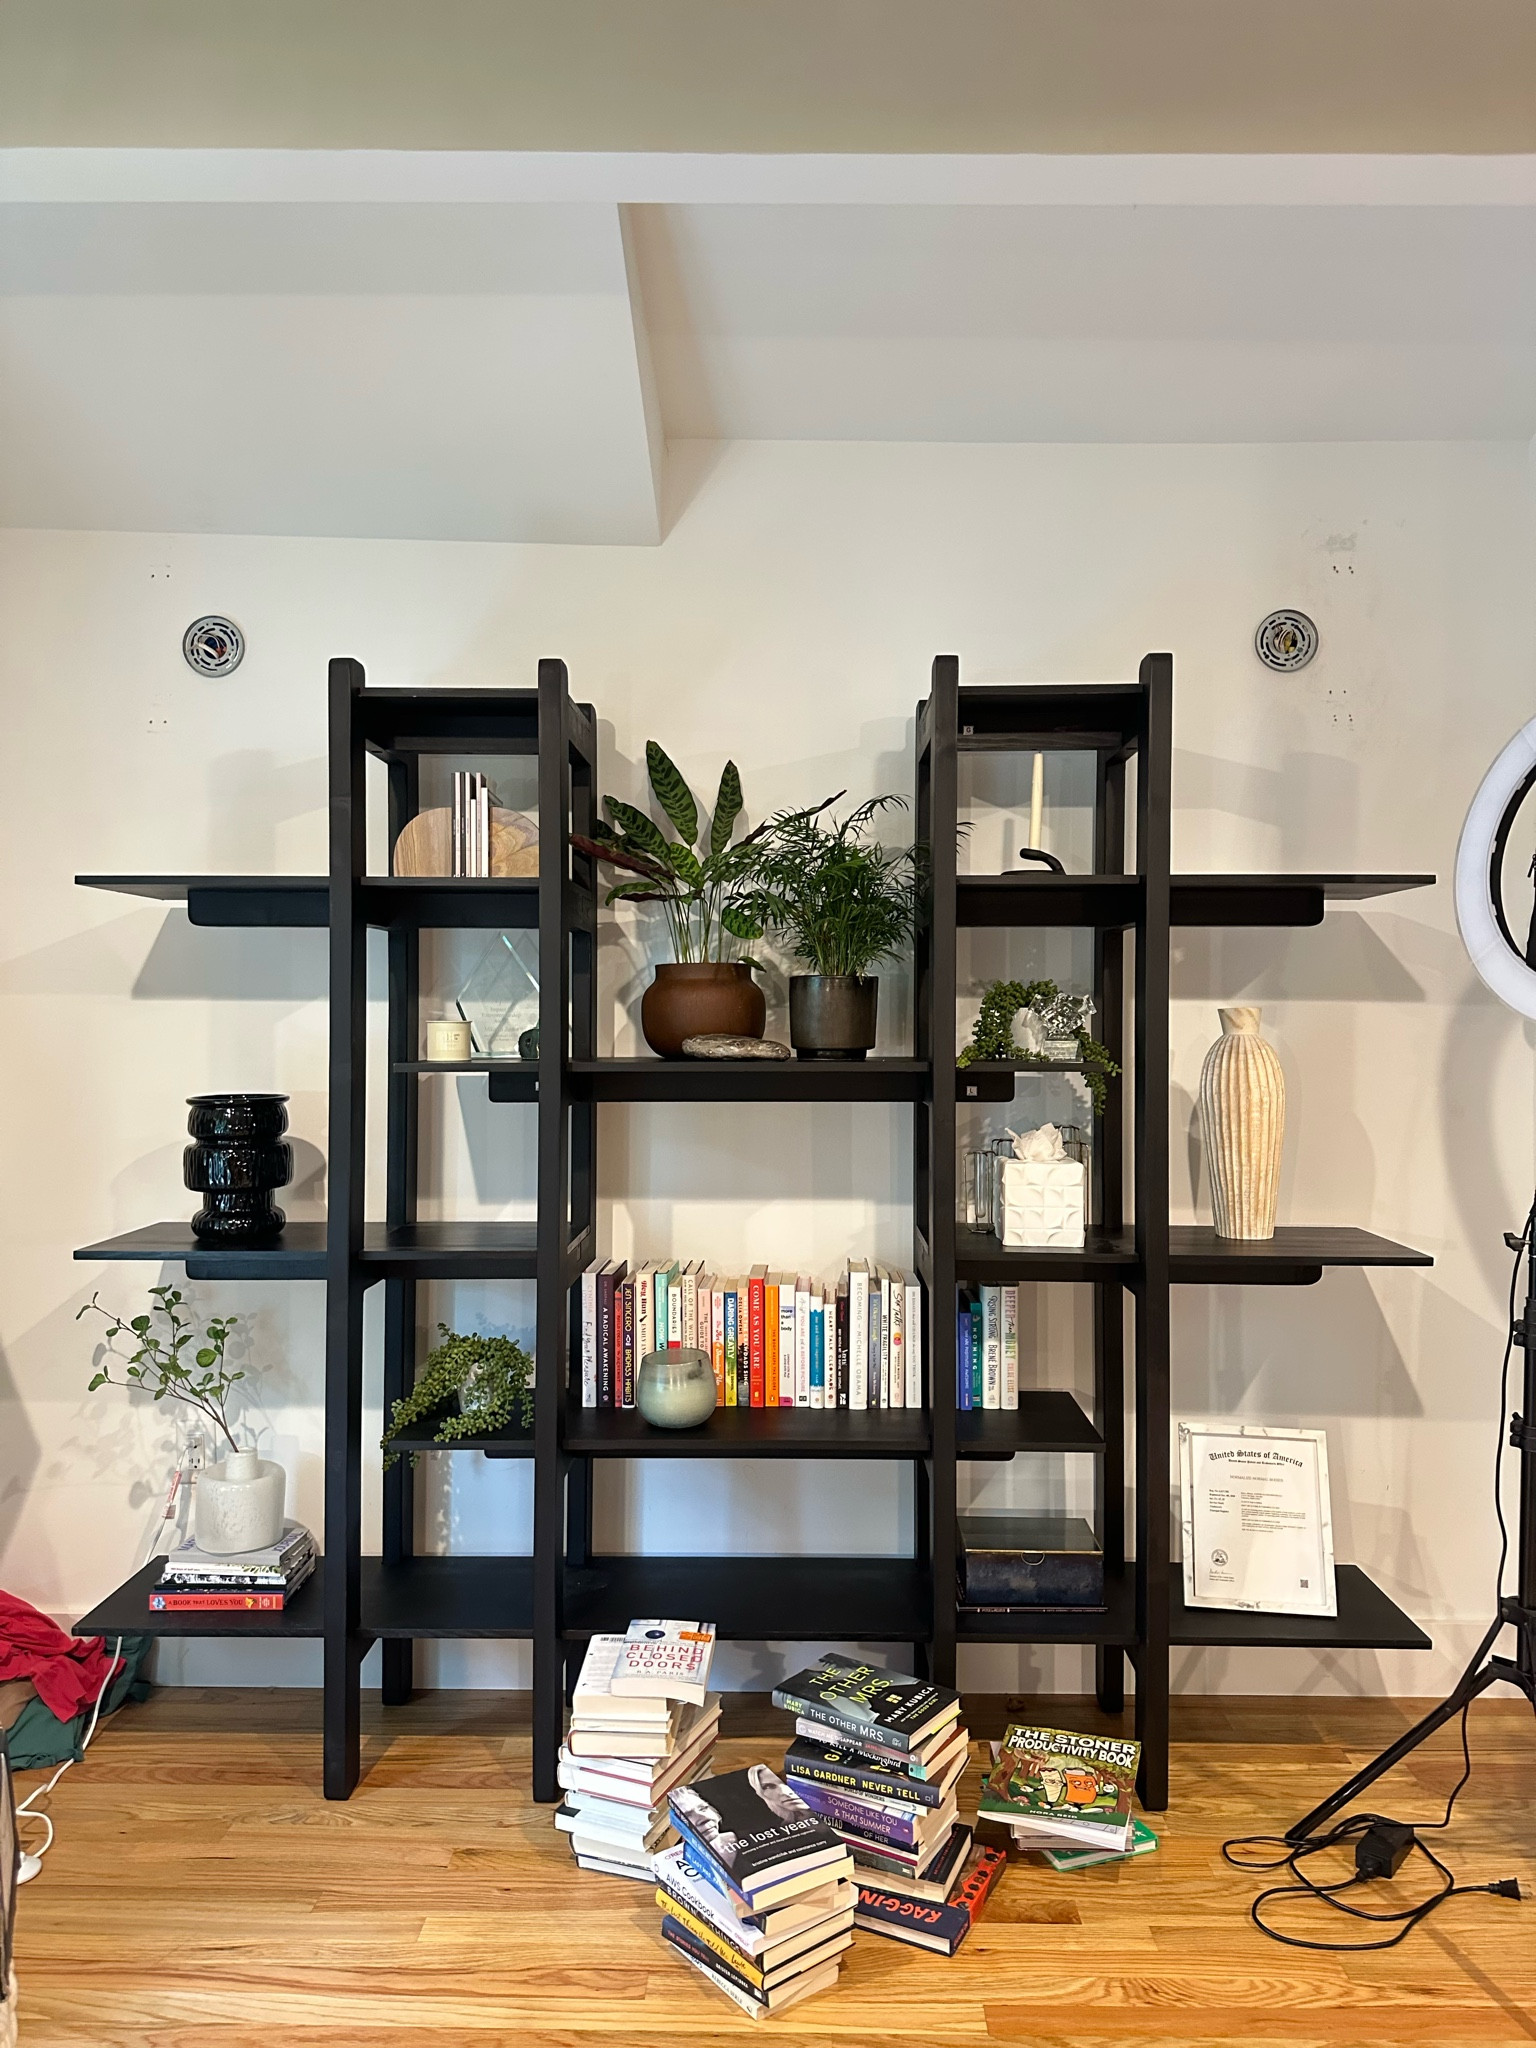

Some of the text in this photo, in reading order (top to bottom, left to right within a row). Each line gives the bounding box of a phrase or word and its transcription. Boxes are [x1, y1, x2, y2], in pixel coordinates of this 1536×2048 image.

[688, 1298, 694, 1306] OF
[893, 1290, 903, 1327] Sex Talks
[753, 1314, 760, 1326] AS
[988, 1318, 998, 1339] STRONG
[1005, 1290, 1016, 1360] DEEPER MONEY
[700, 1340, 704, 1348] TO
[714, 1348, 722, 1374] Showing
[988, 1364, 998, 1385] BROWN
[1208, 1450, 1234, 1460] United
[1236, 1450, 1262, 1458] States
[1272, 1452, 1303, 1468] America
[626, 1652, 703, 1663] CLOSED
[630, 1644, 704, 1655] BEHIND
[629, 1660, 696, 1671] DOORS
[809, 1666, 842, 1685] THE
[820, 1666, 874, 1700] OTHER
[850, 1678, 894, 1704] MRS.
[784, 1704, 805, 1716] KUBICA
[786, 1698, 803, 1708] MARY
[884, 1706, 907, 1724] MARY
[906, 1686, 935, 1708] KUBICA
[810, 1708, 886, 1744] THE OTHER MRS.
[834, 1734, 862, 1747] DISAPPEAR
[1014, 1728, 1136, 1754] THE STONER
[858, 1750, 901, 1768] Mockingbird
[1008, 1735, 1134, 1768] PRODUCTIVITY BOOK
[791, 1764, 920, 1800] LISA GARDNER NEVER TELL
[828, 1796, 898, 1826] SOMEONE LIKE YOU
[842, 1811, 858, 1822] THAT
[860, 1816, 891, 1834] SUMMER
[724, 1839, 749, 1854] the
[750, 1828, 780, 1843] lost
[780, 1817, 819, 1835] years
[864, 1830, 889, 1844] OF HER
[666, 1874, 714, 1920] AWS Cookbook
[712, 1973, 730, 1993] REBECCA
